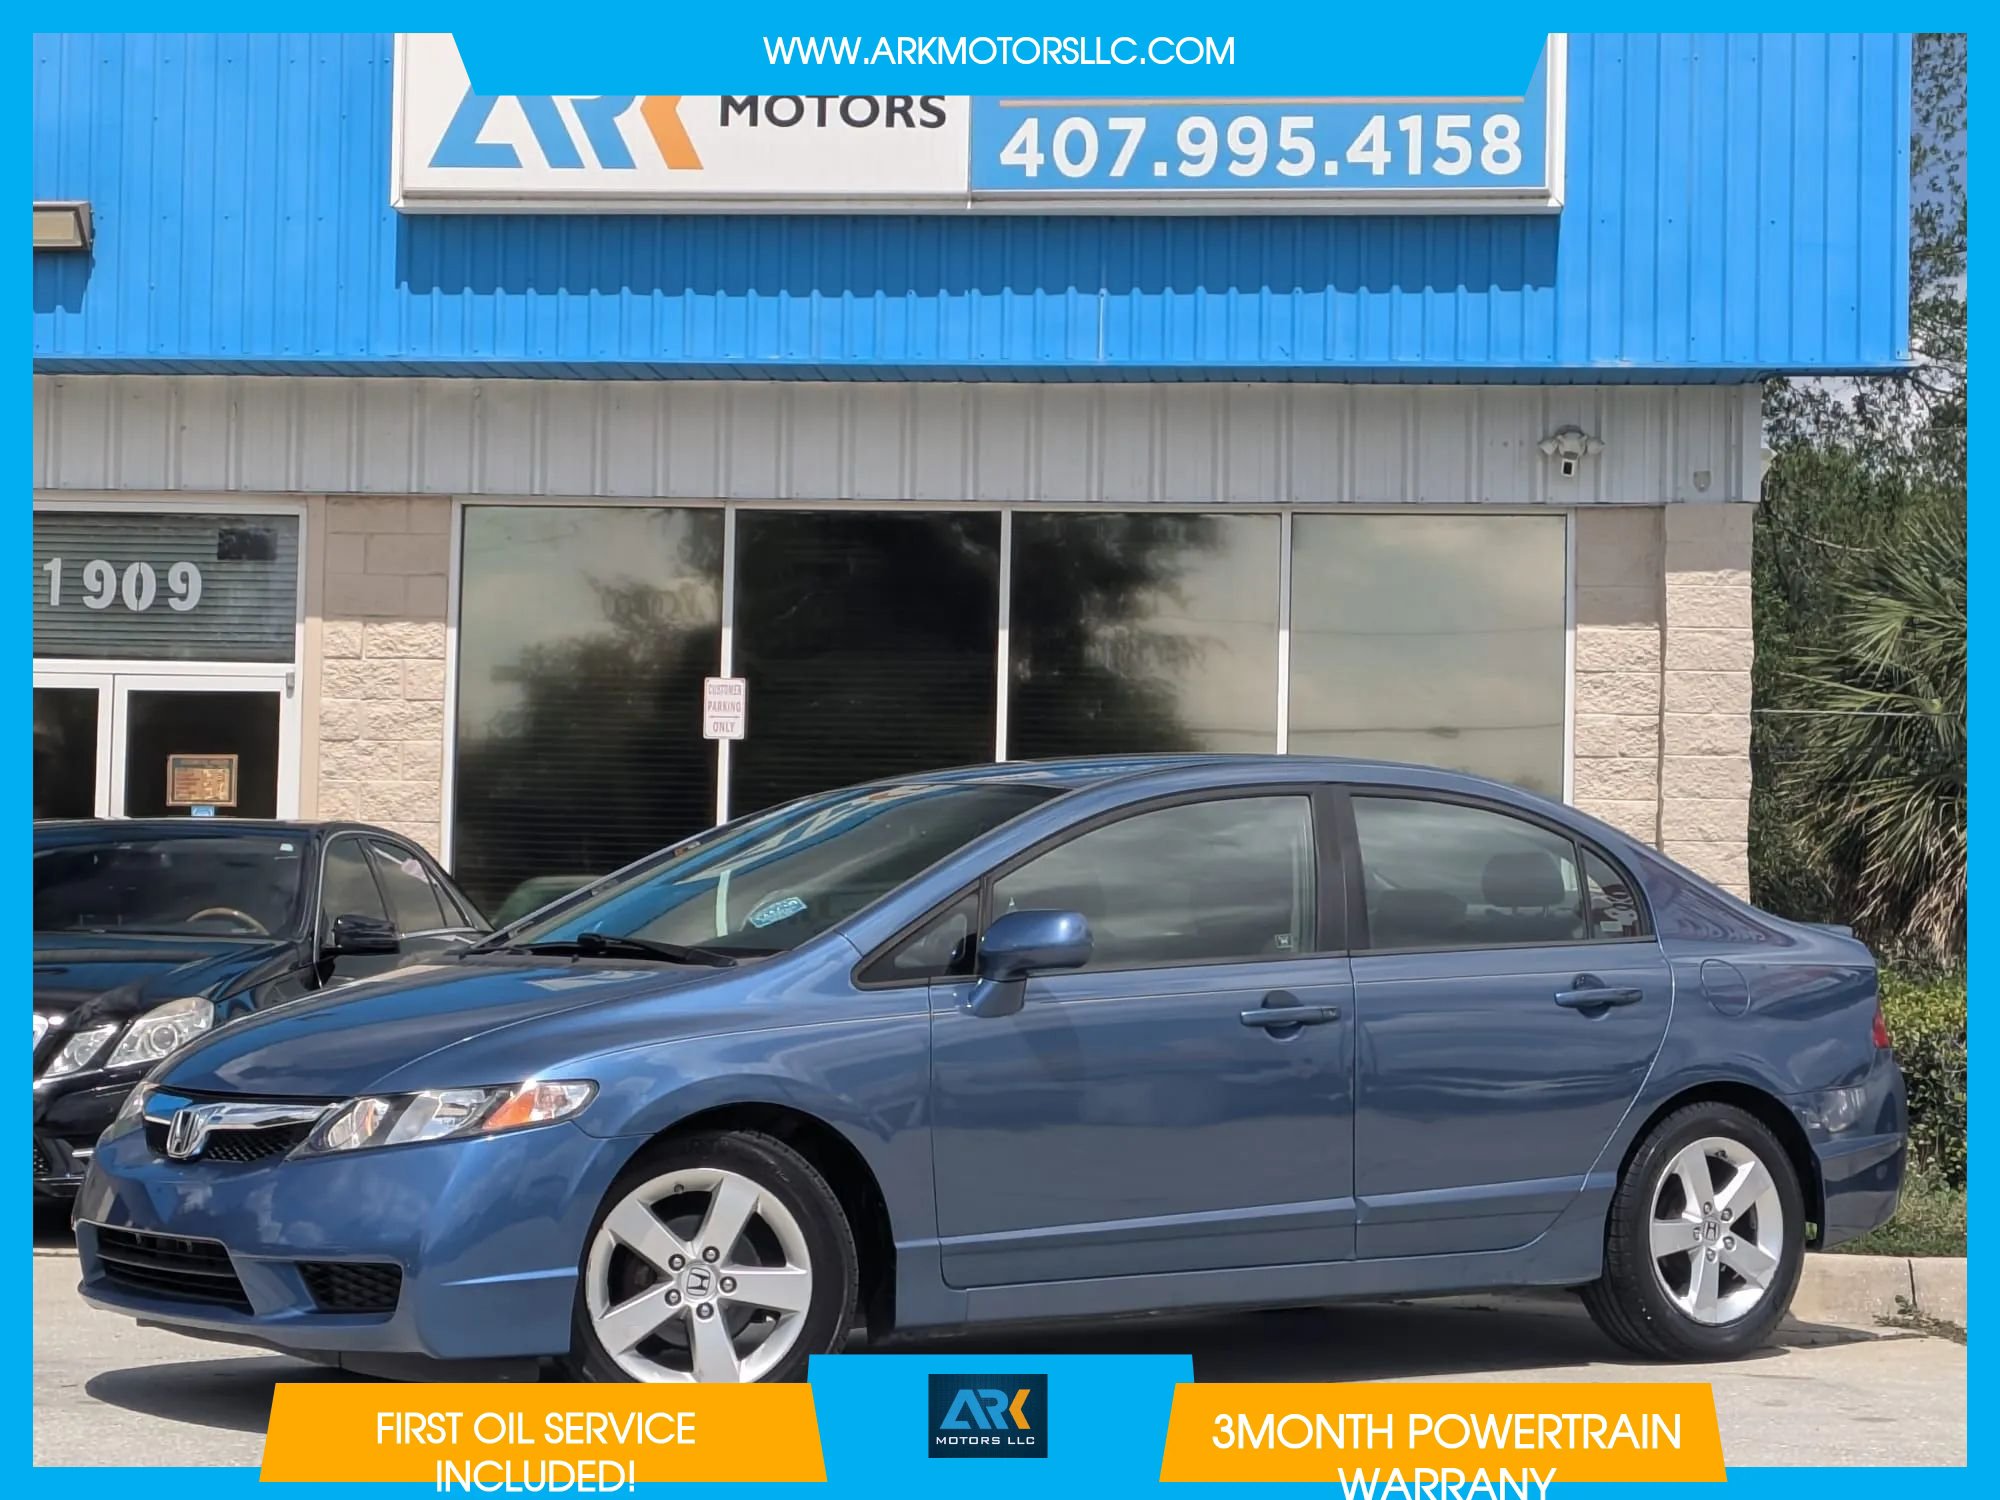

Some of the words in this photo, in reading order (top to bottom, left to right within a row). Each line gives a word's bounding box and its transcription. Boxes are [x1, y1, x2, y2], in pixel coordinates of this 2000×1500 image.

[719, 95, 947, 129] MOTORS
[1000, 114, 1523, 177] 407.995.4158
[43, 557, 202, 612] 1909
[707, 701, 742, 713] PARKING
[712, 721, 736, 733] ONLY
